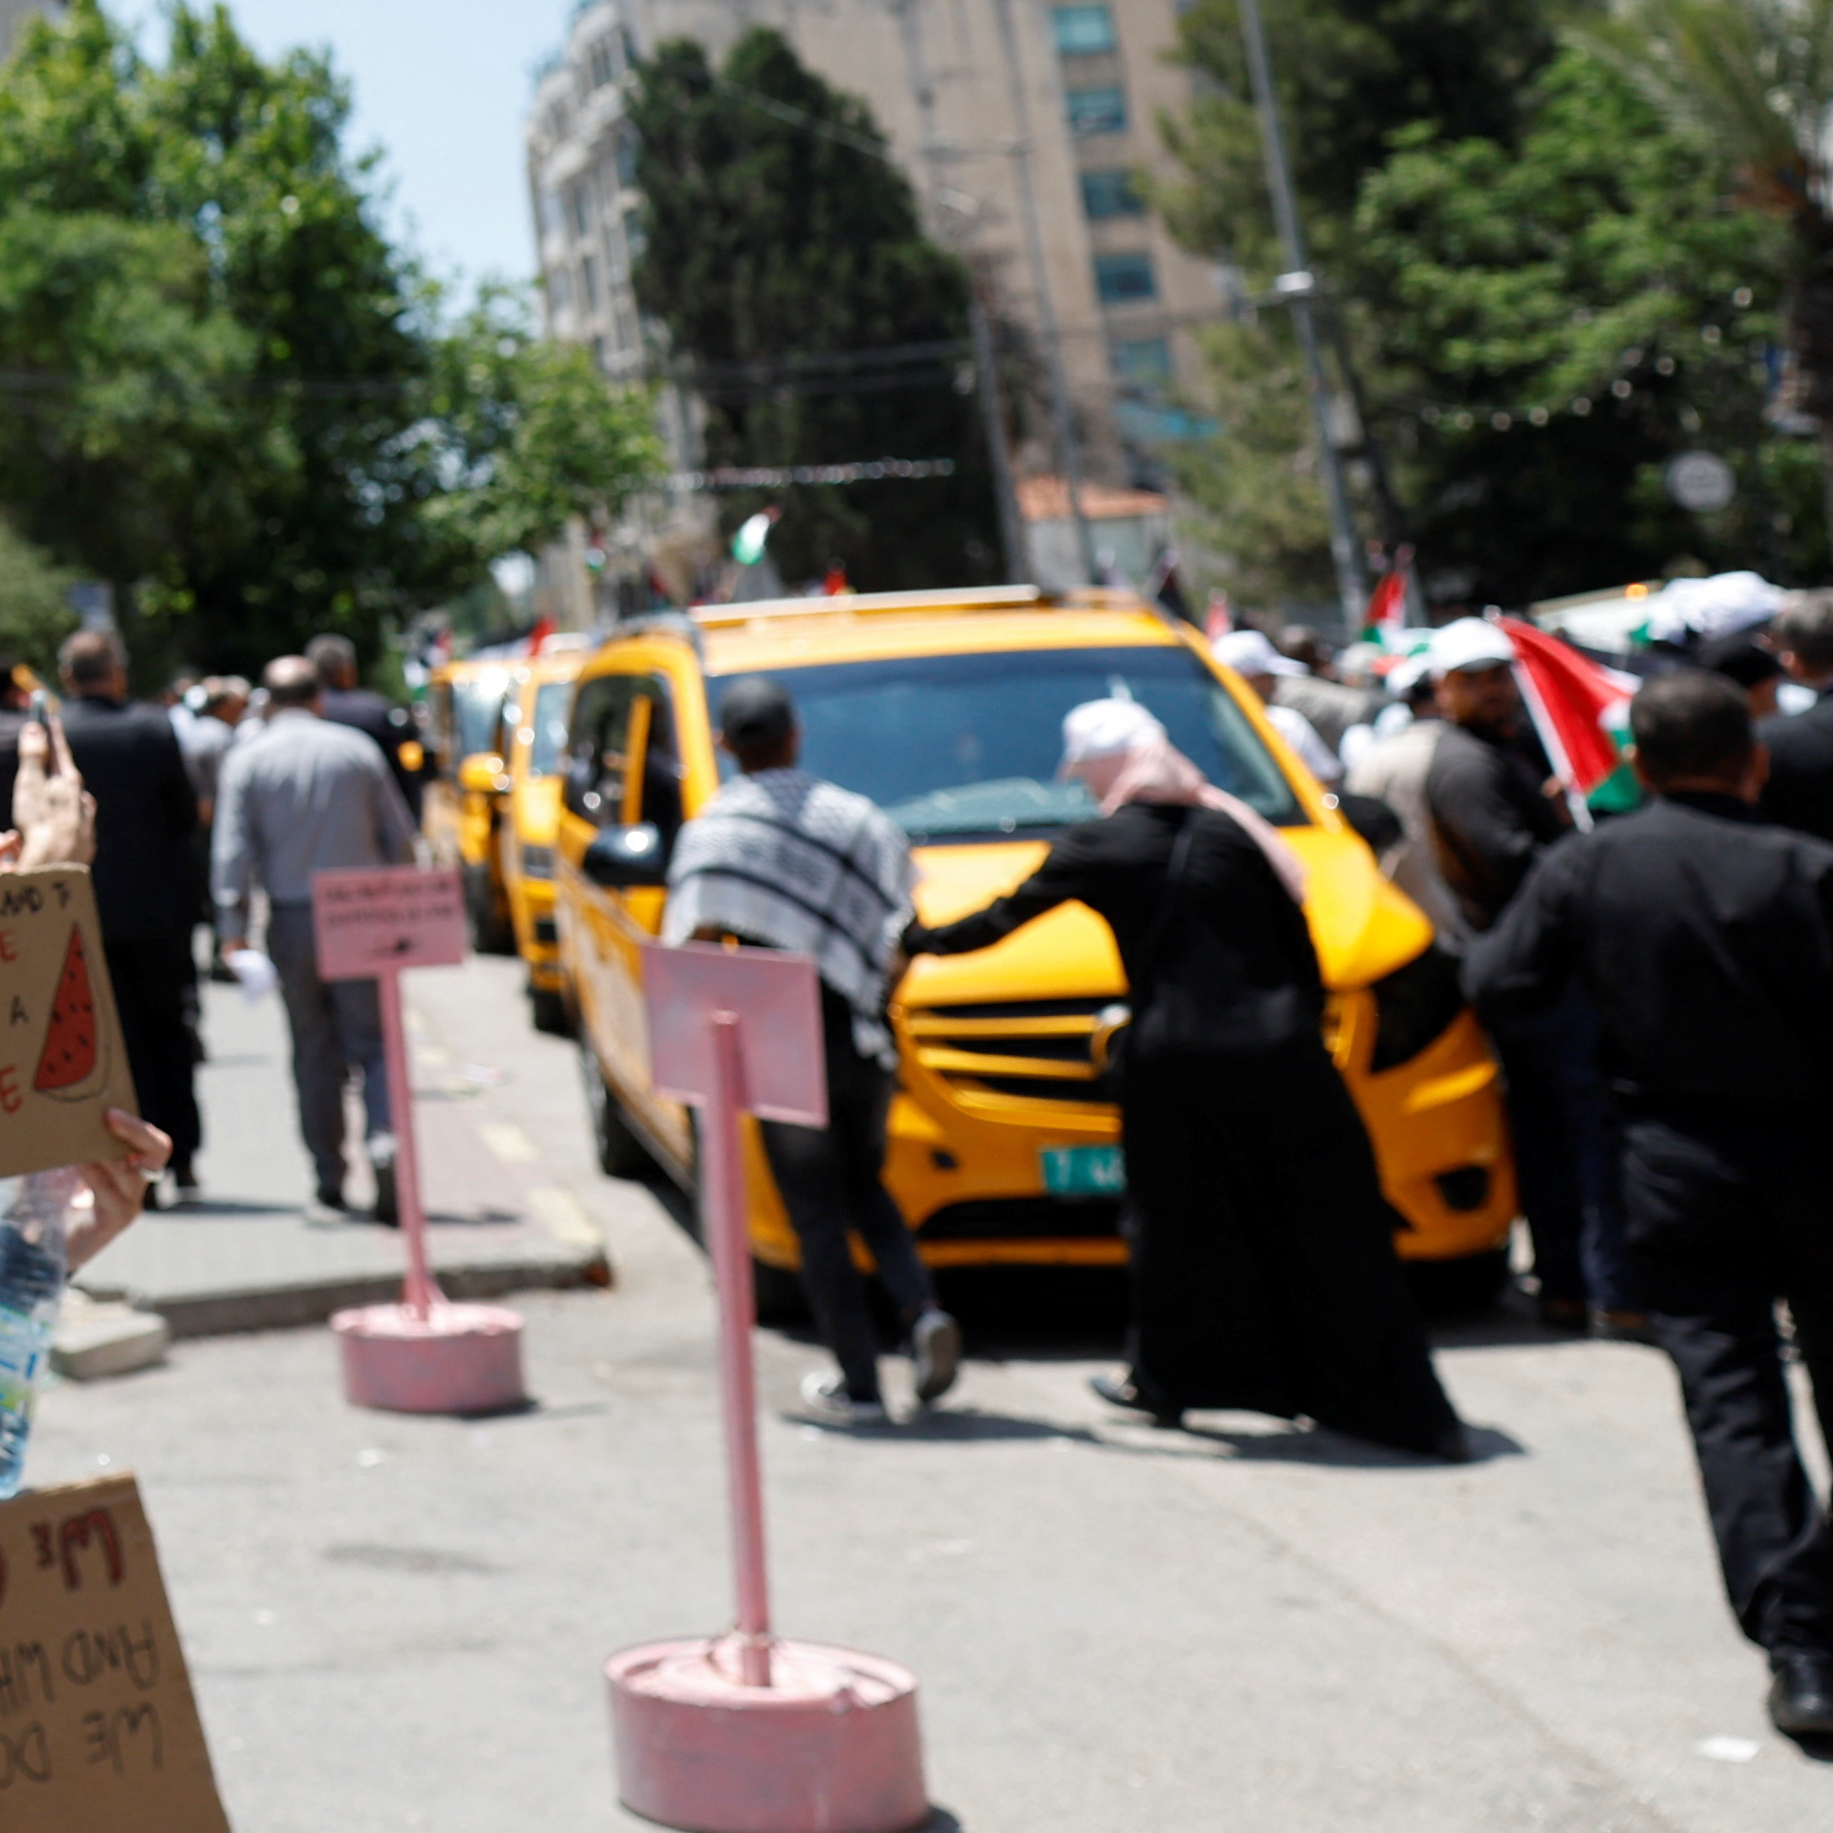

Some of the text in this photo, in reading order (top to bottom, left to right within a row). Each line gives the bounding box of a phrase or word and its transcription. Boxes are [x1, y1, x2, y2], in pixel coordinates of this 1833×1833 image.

[9, 994, 30, 1027] A
[62, 1618, 162, 1691] AND
[83, 1702, 163, 1776] WE
